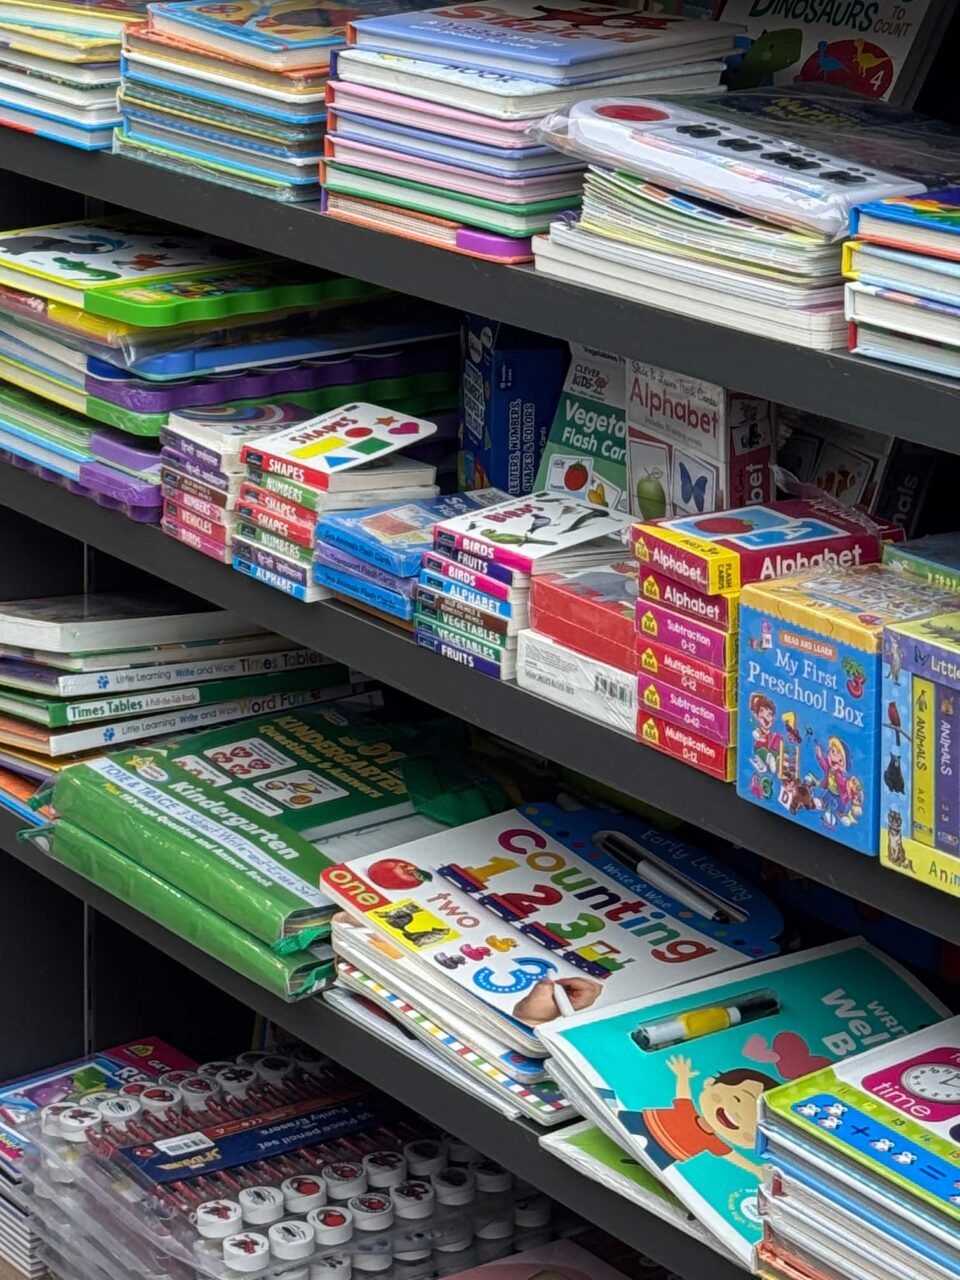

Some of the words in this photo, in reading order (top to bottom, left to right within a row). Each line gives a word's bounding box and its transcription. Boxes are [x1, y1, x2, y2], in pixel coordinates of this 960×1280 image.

[891, 5, 906, 20] TO
[873, 19, 913, 38] COUNT
[868, 71, 884, 91] 4
[575, 363, 600, 378] CLEVER
[629, 377, 720, 439] Alphabet
[289, 416, 359, 445] SHAPES
[562, 428, 599, 454] Flash
[269, 458, 305, 482] SHAPES
[266, 476, 303, 503] NUMBERS
[265, 496, 297, 519] SHAPES
[257, 513, 289, 536] SHAPES
[261, 532, 300, 559] NUMBERS
[462, 538, 495, 560] BIRDS
[448, 566, 477, 587] BIRDS
[457, 551, 489, 574] FRUITS
[653, 546, 702, 583] Alphabet
[760, 544, 862, 581] Alphabet
[256, 567, 296, 595] ALPHABET
[449, 583, 501, 611] ALPHABET
[664, 585, 720, 619] Alphabet
[442, 612, 501, 644] VEGETABLES
[667, 620, 711, 647] Subtraction
[436, 628, 496, 660] VEGETABLES
[441, 646, 475, 669] FRUITS
[142, 669, 171, 684] Learning
[175, 667, 195, 679] Write
[197, 664, 213, 676] and
[664, 653, 714, 687] Multiplication
[775, 649, 800, 675] My
[802, 659, 838, 691] First
[71, 704, 105, 720] Times
[107, 699, 143, 715] Tables
[280, 691, 306, 709] Fun
[669, 692, 715, 722] Subtraction
[748, 661, 828, 713] Preschool
[832, 699, 864, 728] Box
[277, 715, 408, 796] KINDERGARTEN
[665, 727, 715, 758] Multiplication
[915, 714, 927, 772] ANIMALS
[940, 719, 953, 777] ANIMALS
[168, 781, 300, 860] Kindergarten
[640, 829, 685, 862] Early
[689, 852, 754, 903] Learning
[327, 869, 380, 907] one
[498, 827, 719, 964] Counting
[603, 862, 631, 886] Write
[644, 886, 671, 910] Wipe
[426, 893, 481, 930] two
[494, 883, 563, 920] 2
[870, 1078, 932, 1118] time
